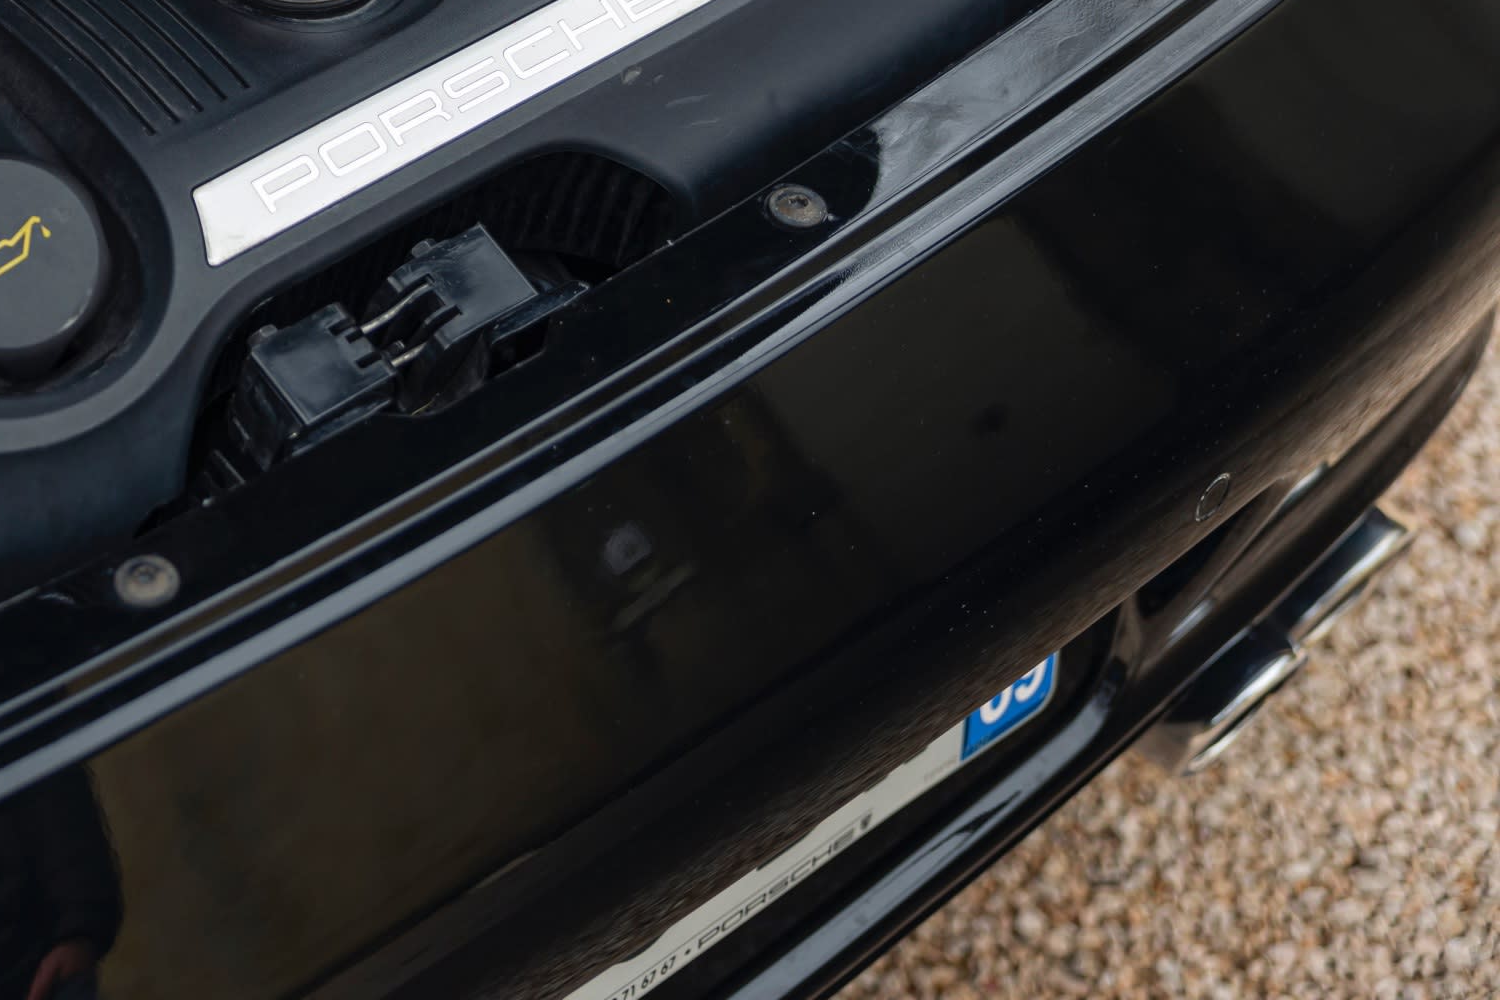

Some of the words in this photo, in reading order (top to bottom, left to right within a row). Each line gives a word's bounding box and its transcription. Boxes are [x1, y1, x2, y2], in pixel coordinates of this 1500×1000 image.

[621, 985, 635, 1000] 71
[641, 970, 656, 989] 67
[661, 956, 676, 975] 67
[698, 828, 855, 949] PORSCHE
